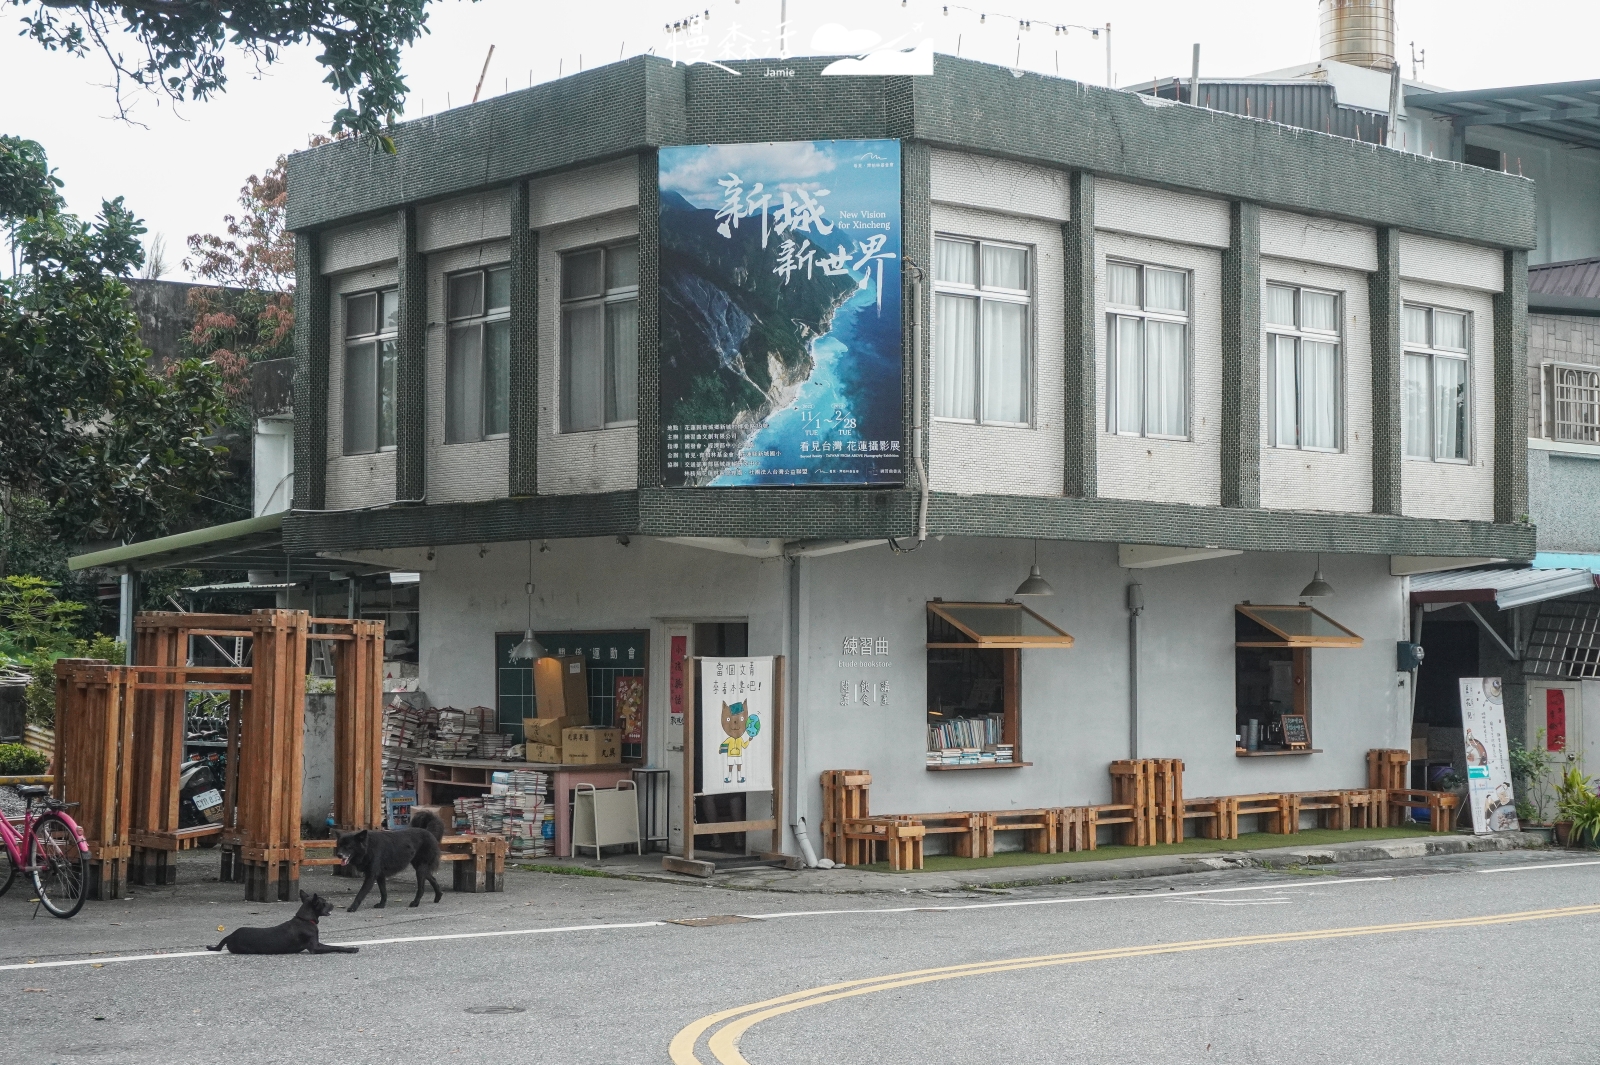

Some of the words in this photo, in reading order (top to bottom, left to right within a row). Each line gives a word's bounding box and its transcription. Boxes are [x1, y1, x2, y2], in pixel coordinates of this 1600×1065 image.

[715, 172, 834, 250] 新城
[839, 211, 859, 219] New
[860, 211, 887, 219] Vision
[838, 221, 851, 230] for
[852, 221, 891, 231] Xincheng
[772, 233, 897, 319] 新世界
[800, 440, 843, 452] 看見台灣
[847, 440, 901, 452] 花蓮攝影展
[842, 636, 889, 656] 練習曲
[716, 661, 755, 677] 當個文青
[859, 660, 892, 668] bookstore
